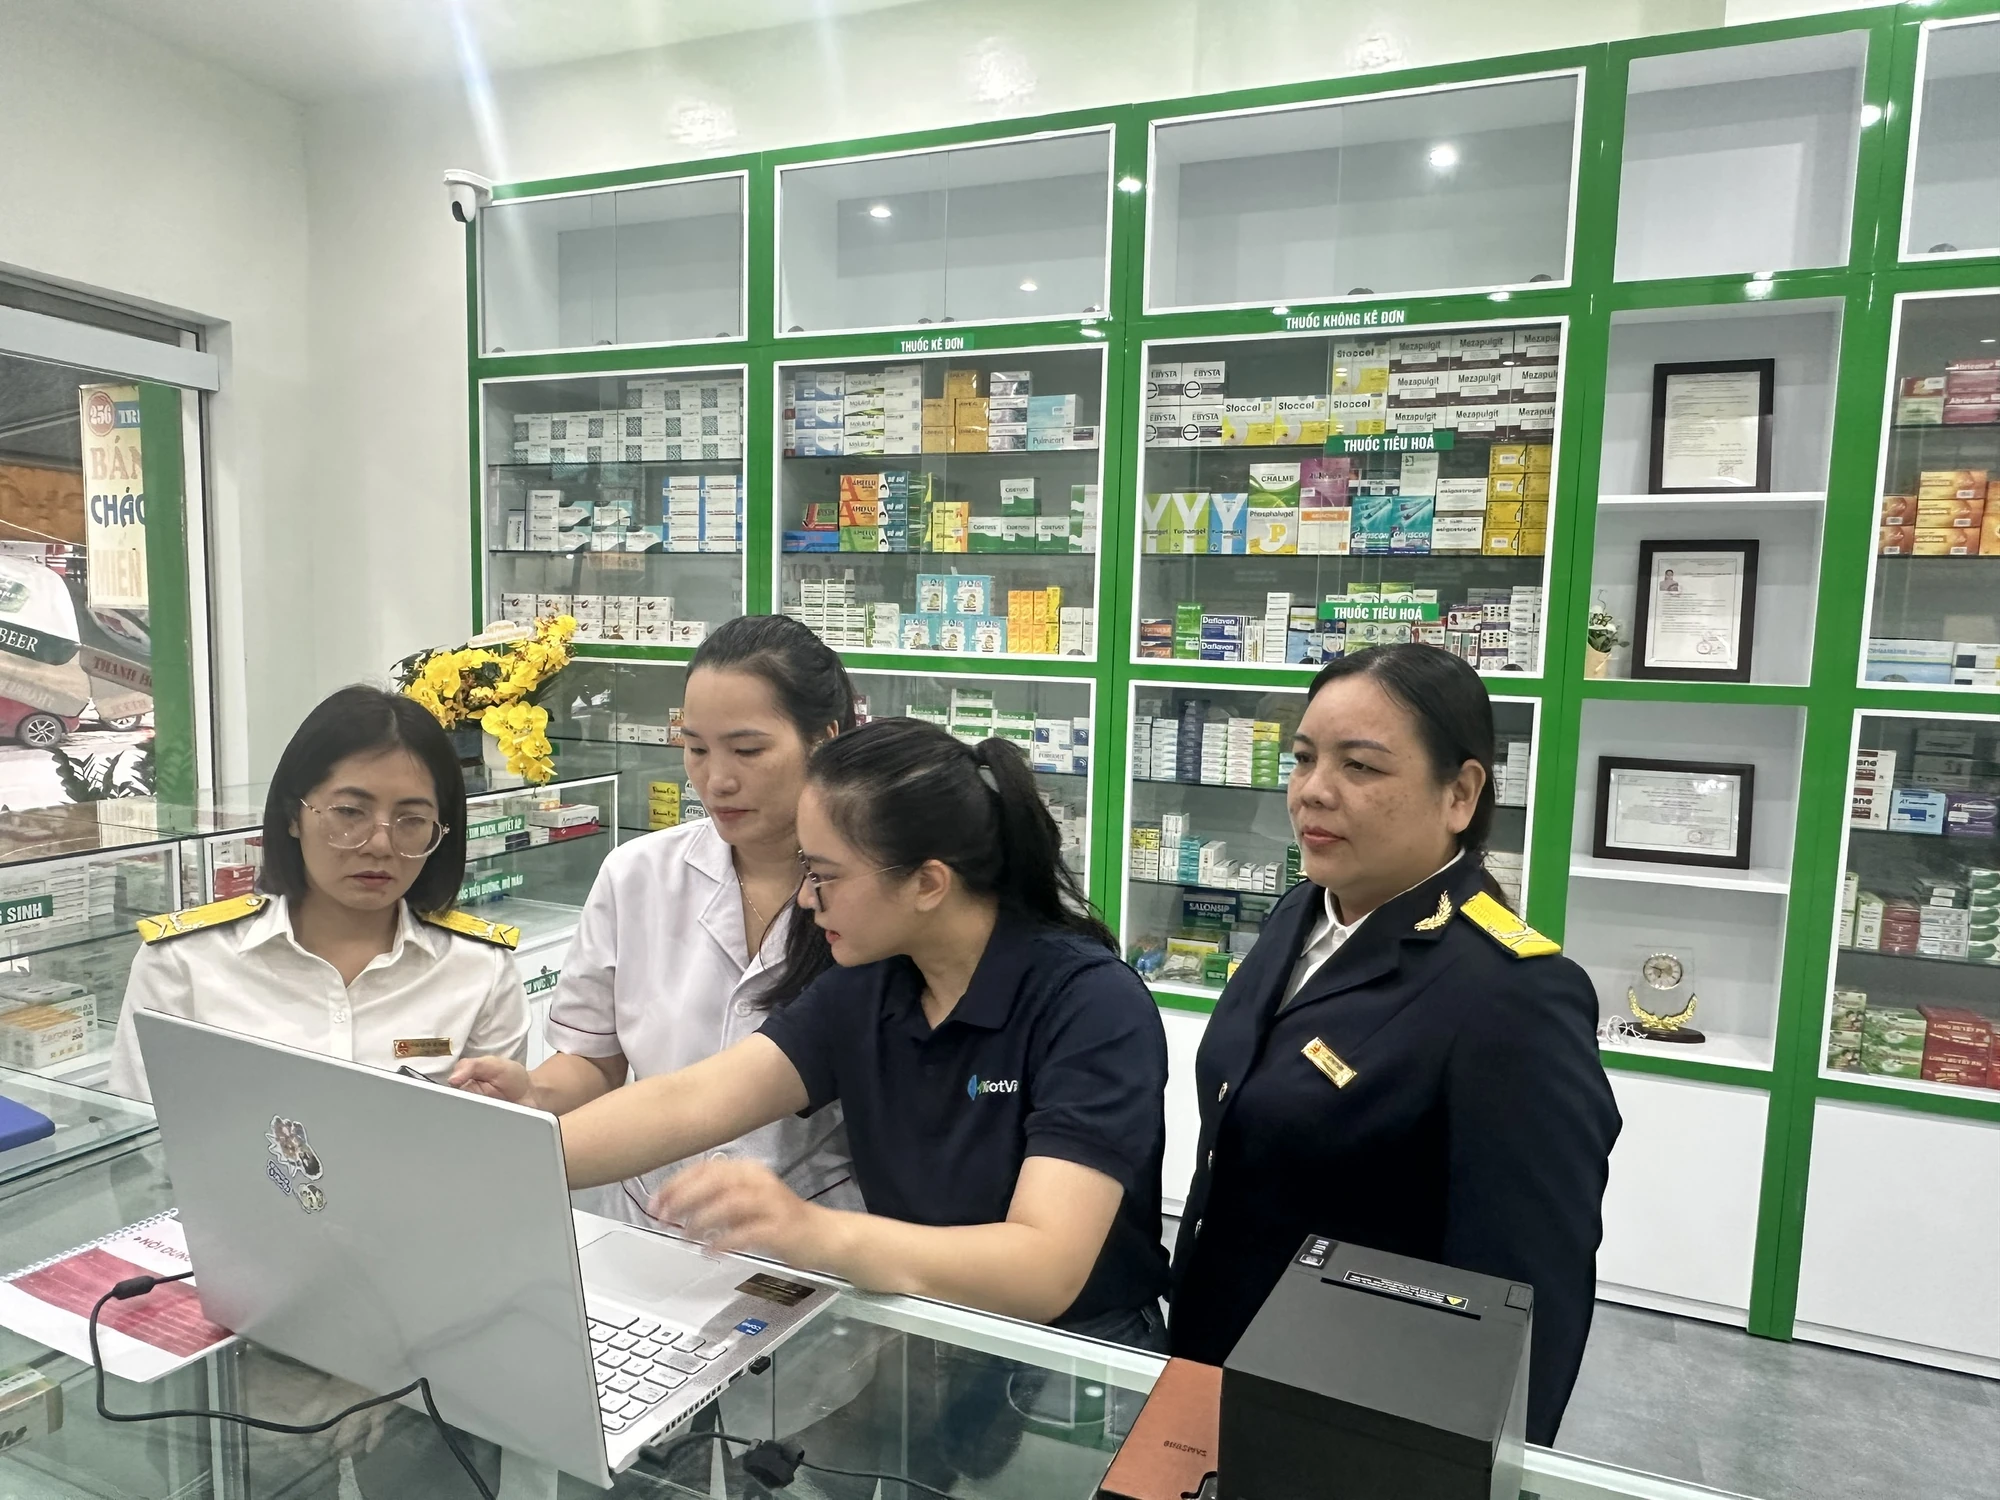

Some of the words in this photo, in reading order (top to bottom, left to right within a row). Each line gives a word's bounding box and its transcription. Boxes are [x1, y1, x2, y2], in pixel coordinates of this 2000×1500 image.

[1286, 312, 1320, 329] THUỐC
[1323, 311, 1361, 327] KHÔNG
[1363, 309, 1378, 325] KÊ
[1381, 308, 1405, 324] ĐƠN
[1460, 337, 1503, 348] Mezapulgit
[1524, 334, 1559, 344] Mezapul
[901, 337, 929, 353] THUỐC
[944, 337, 964, 351] ĐƠN
[1337, 347, 1374, 358] Stoccel
[1458, 373, 1501, 383] Mezapulgit
[1522, 370, 1557, 380] Mezapul
[1397, 376, 1439, 387] Mezapulgit
[1225, 403, 1261, 412] Stoccel
[1278, 401, 1315, 411] Stoccel
[1333, 399, 1370, 409] Stoccel
[1395, 412, 1437, 423] Mezapulgit
[1456, 409, 1499, 420] Mezapulgit
[1519, 407, 1555, 418] Mezapul
[1344, 435, 1380, 451] THUỐC
[1385, 435, 1408, 450] TIÊU
[1411, 435, 1434, 450] HOÁ
[1333, 603, 1369, 619] THUỐC
[1372, 604, 1396, 619] TIÊU
[1400, 605, 1422, 620] HOÁ
[0, 627, 39, 653] BEER
[7, 903, 43, 922] SINH
